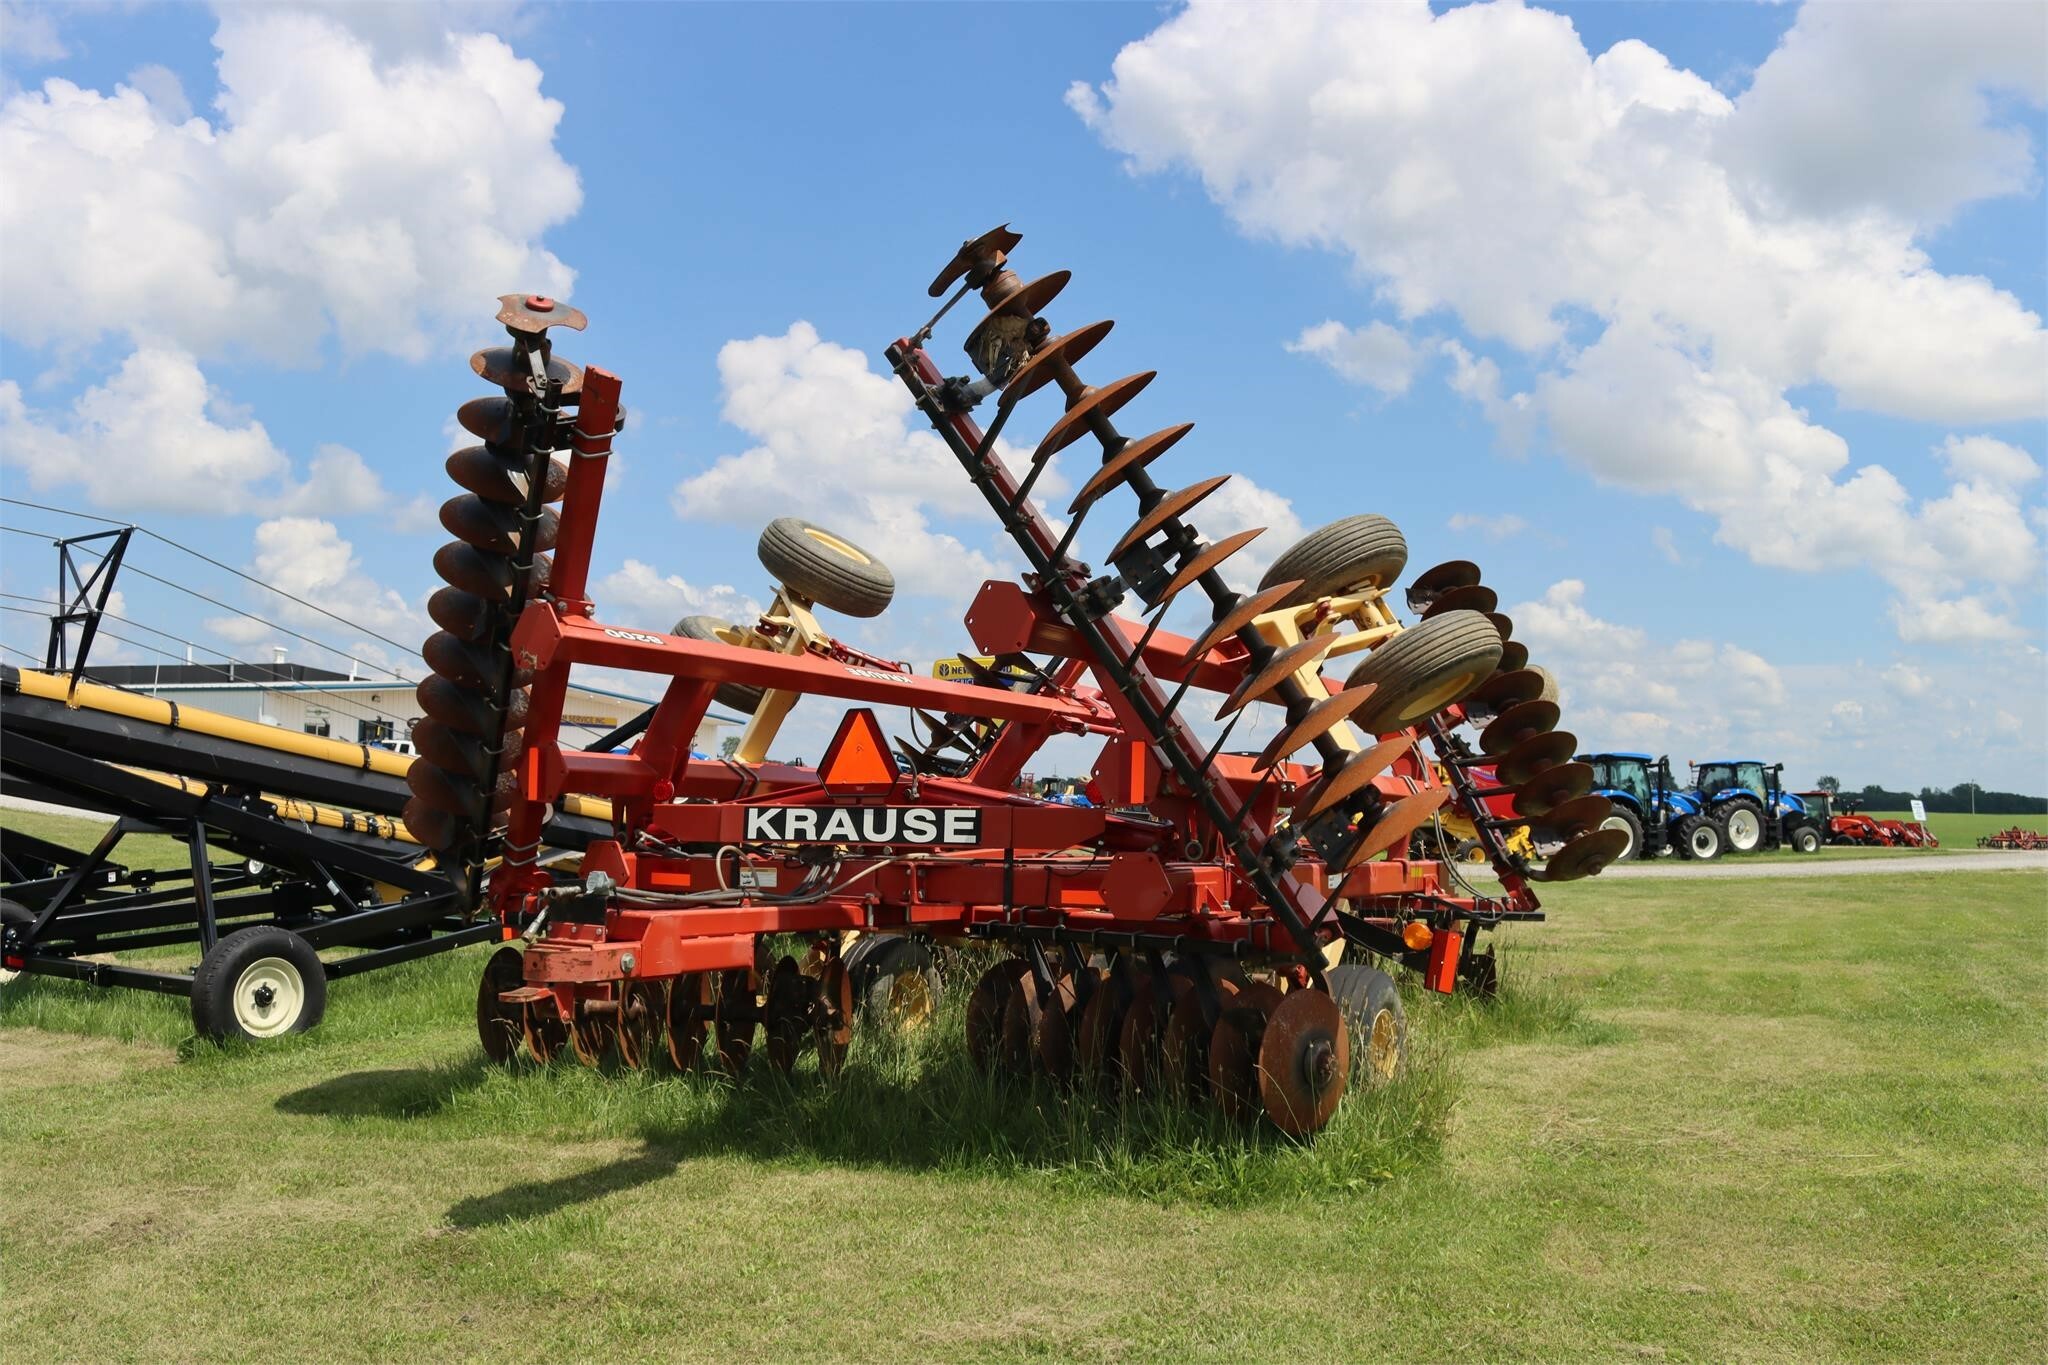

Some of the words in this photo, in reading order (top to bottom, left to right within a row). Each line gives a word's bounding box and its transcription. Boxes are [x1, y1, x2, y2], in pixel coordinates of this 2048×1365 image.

[845, 667, 913, 684] KRAUSE
[568, 715, 593, 724] SERVICE
[747, 807, 977, 844] KRAUSE
